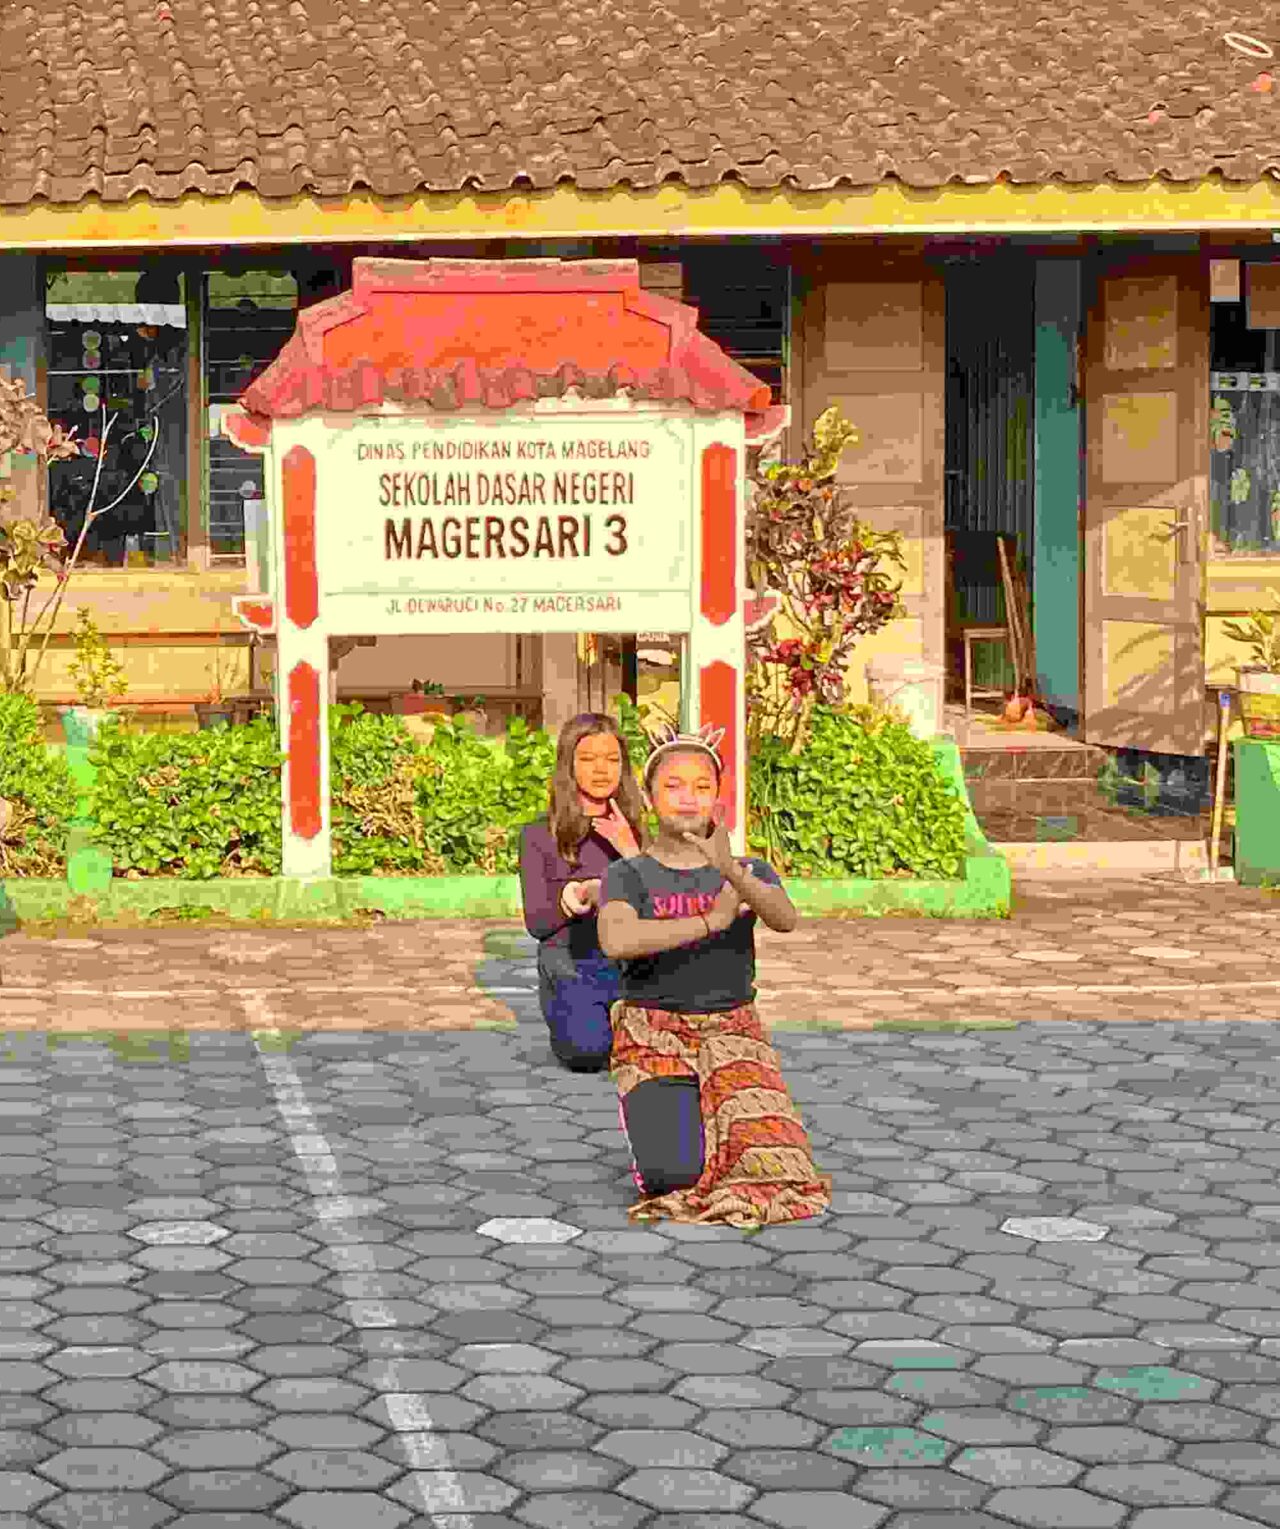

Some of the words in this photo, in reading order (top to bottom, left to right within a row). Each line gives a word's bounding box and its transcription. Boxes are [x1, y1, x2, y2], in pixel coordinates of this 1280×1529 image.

[357, 441, 405, 460] DINAS
[412, 440, 511, 460] PENDIDIKAN
[516, 440, 556, 459] KOTA
[561, 440, 650, 459] MAGELANG
[379, 471, 471, 506] SEKOLAH
[477, 471, 546, 505] DASAR
[553, 471, 634, 505] NEGERI
[385, 514, 592, 559] MAGERSARI
[604, 513, 628, 556] 3
